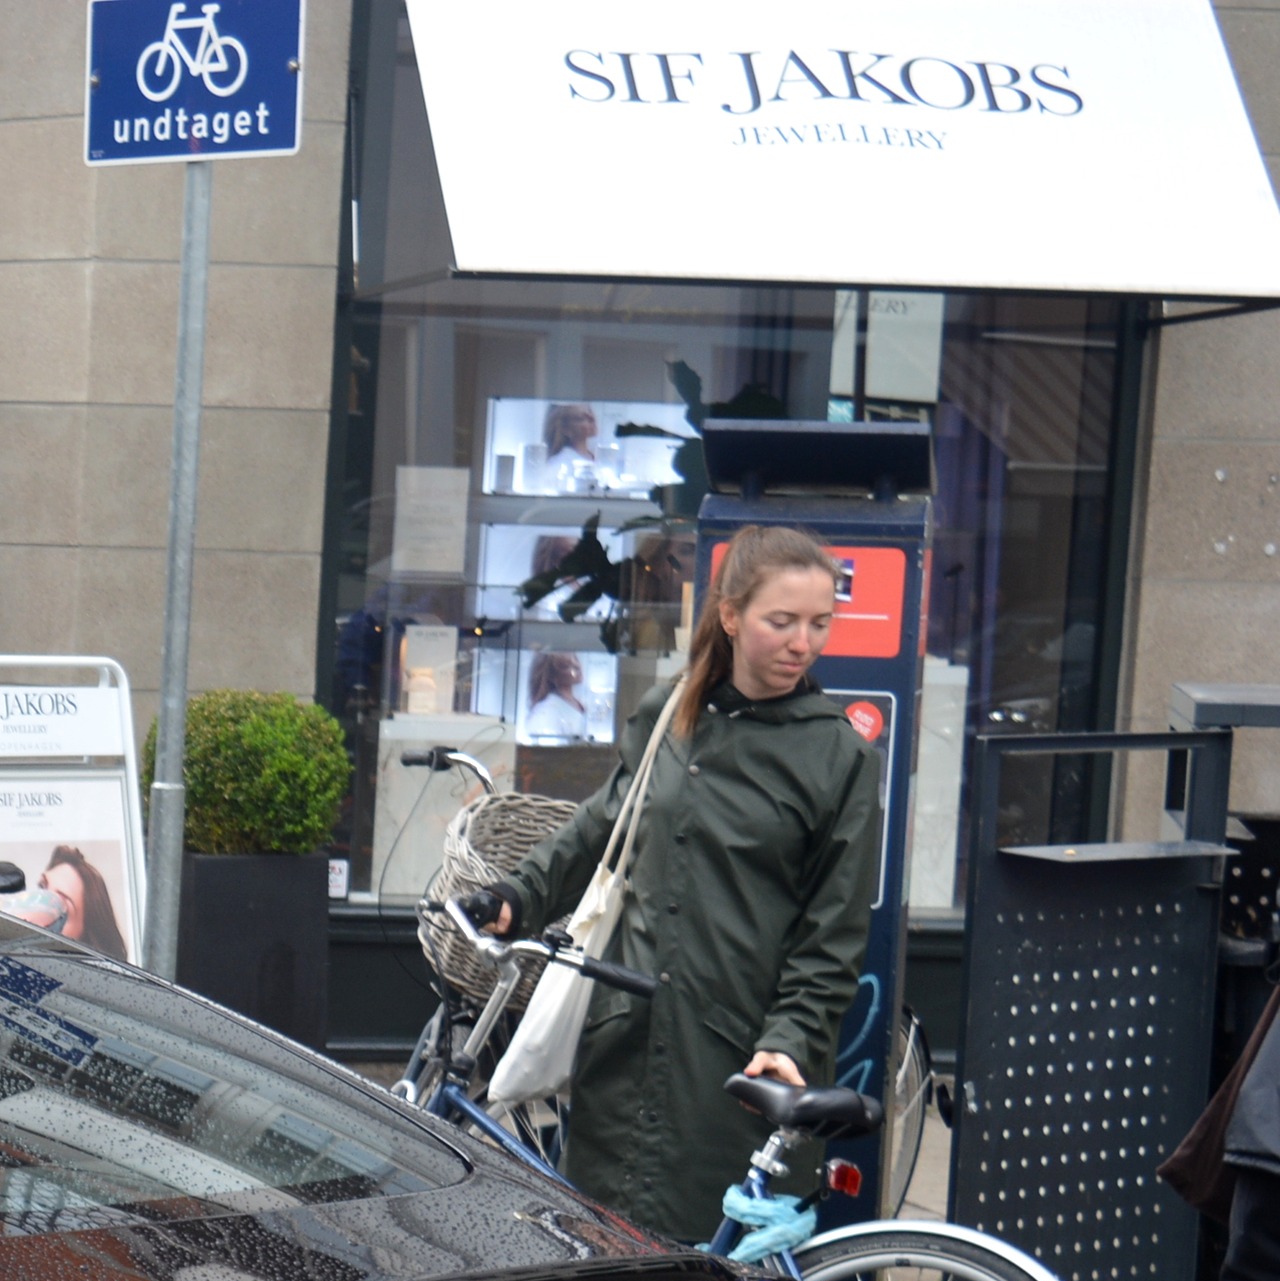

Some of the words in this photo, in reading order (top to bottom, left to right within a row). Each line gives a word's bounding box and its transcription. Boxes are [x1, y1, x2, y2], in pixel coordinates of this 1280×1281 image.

[563, 48, 704, 103] SIF
[720, 48, 1085, 116] JAKOBS
[113, 102, 270, 144] undtaget
[732, 122, 948, 152] JEWELLERY
[0, 692, 78, 720] JAKOBS
[1, 724, 48, 736] JEWELLERY
[16, 791, 64, 810] JAKOBS
